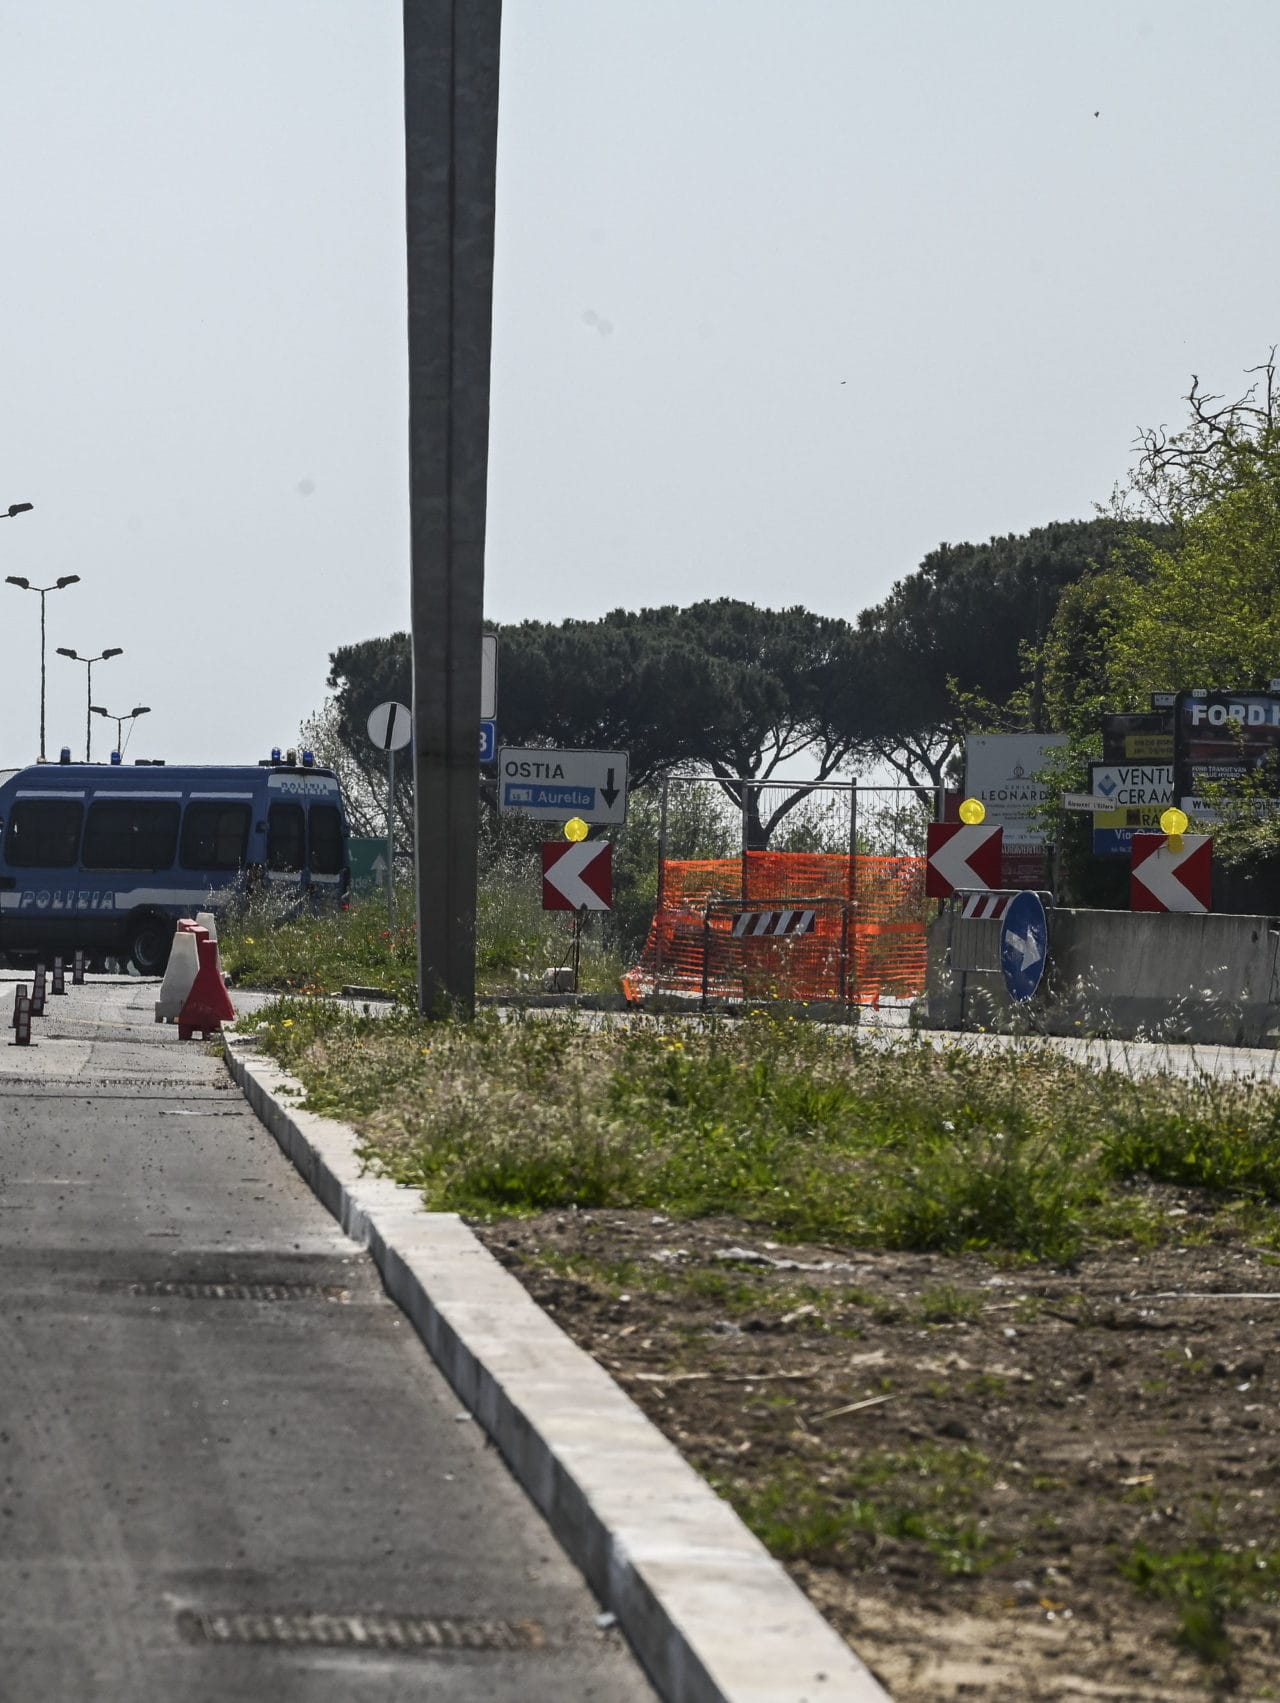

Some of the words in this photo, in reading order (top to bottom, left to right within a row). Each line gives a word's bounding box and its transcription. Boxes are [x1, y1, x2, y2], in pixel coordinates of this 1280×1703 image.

[1192, 704, 1266, 726] FORD
[505, 761, 565, 780] OSTIA
[281, 782, 329, 796] POLIZIA
[538, 791, 591, 805] Aurelia
[1115, 828, 1131, 840] Via
[21, 890, 114, 909] POLIZIA
